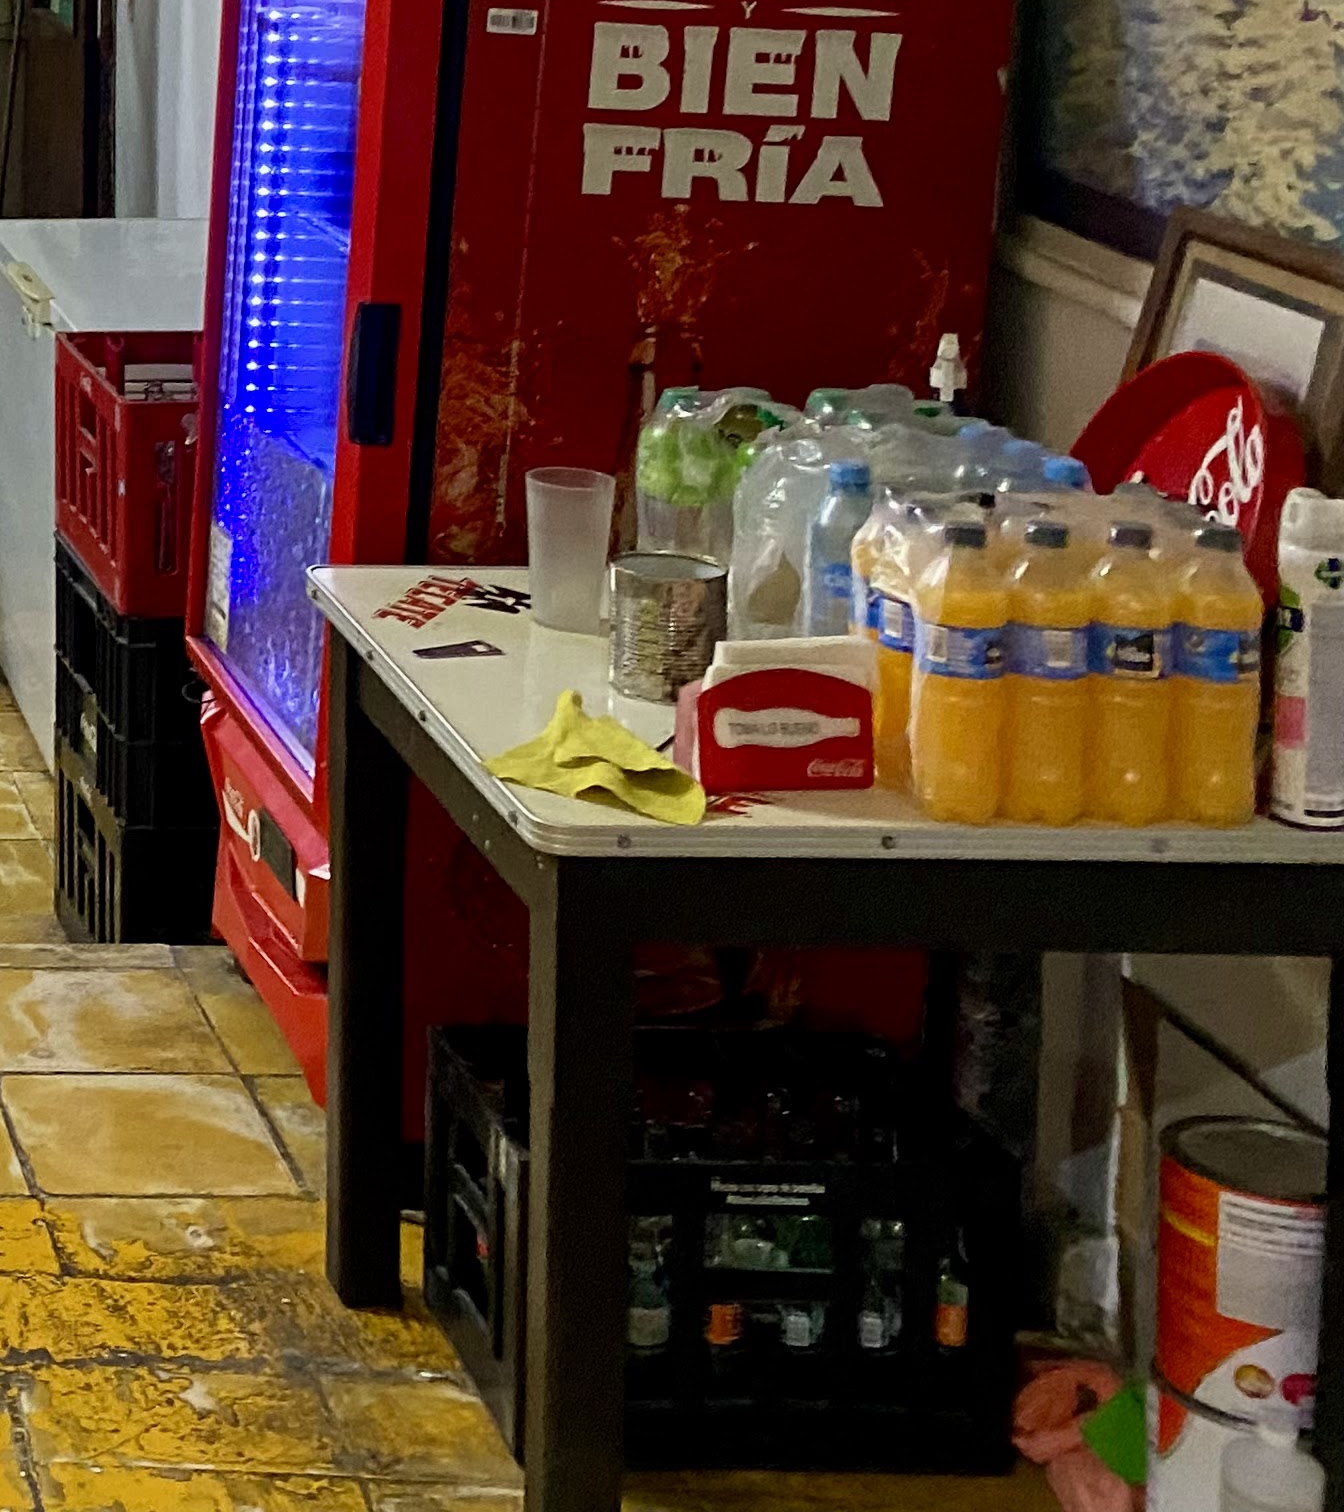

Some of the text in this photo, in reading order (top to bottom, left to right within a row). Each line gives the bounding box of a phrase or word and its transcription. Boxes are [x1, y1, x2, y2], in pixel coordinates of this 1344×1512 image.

[741, 0, 758, 20] Y
[587, 21, 904, 122] BIEN
[581, 123, 884, 208] FRÍA
